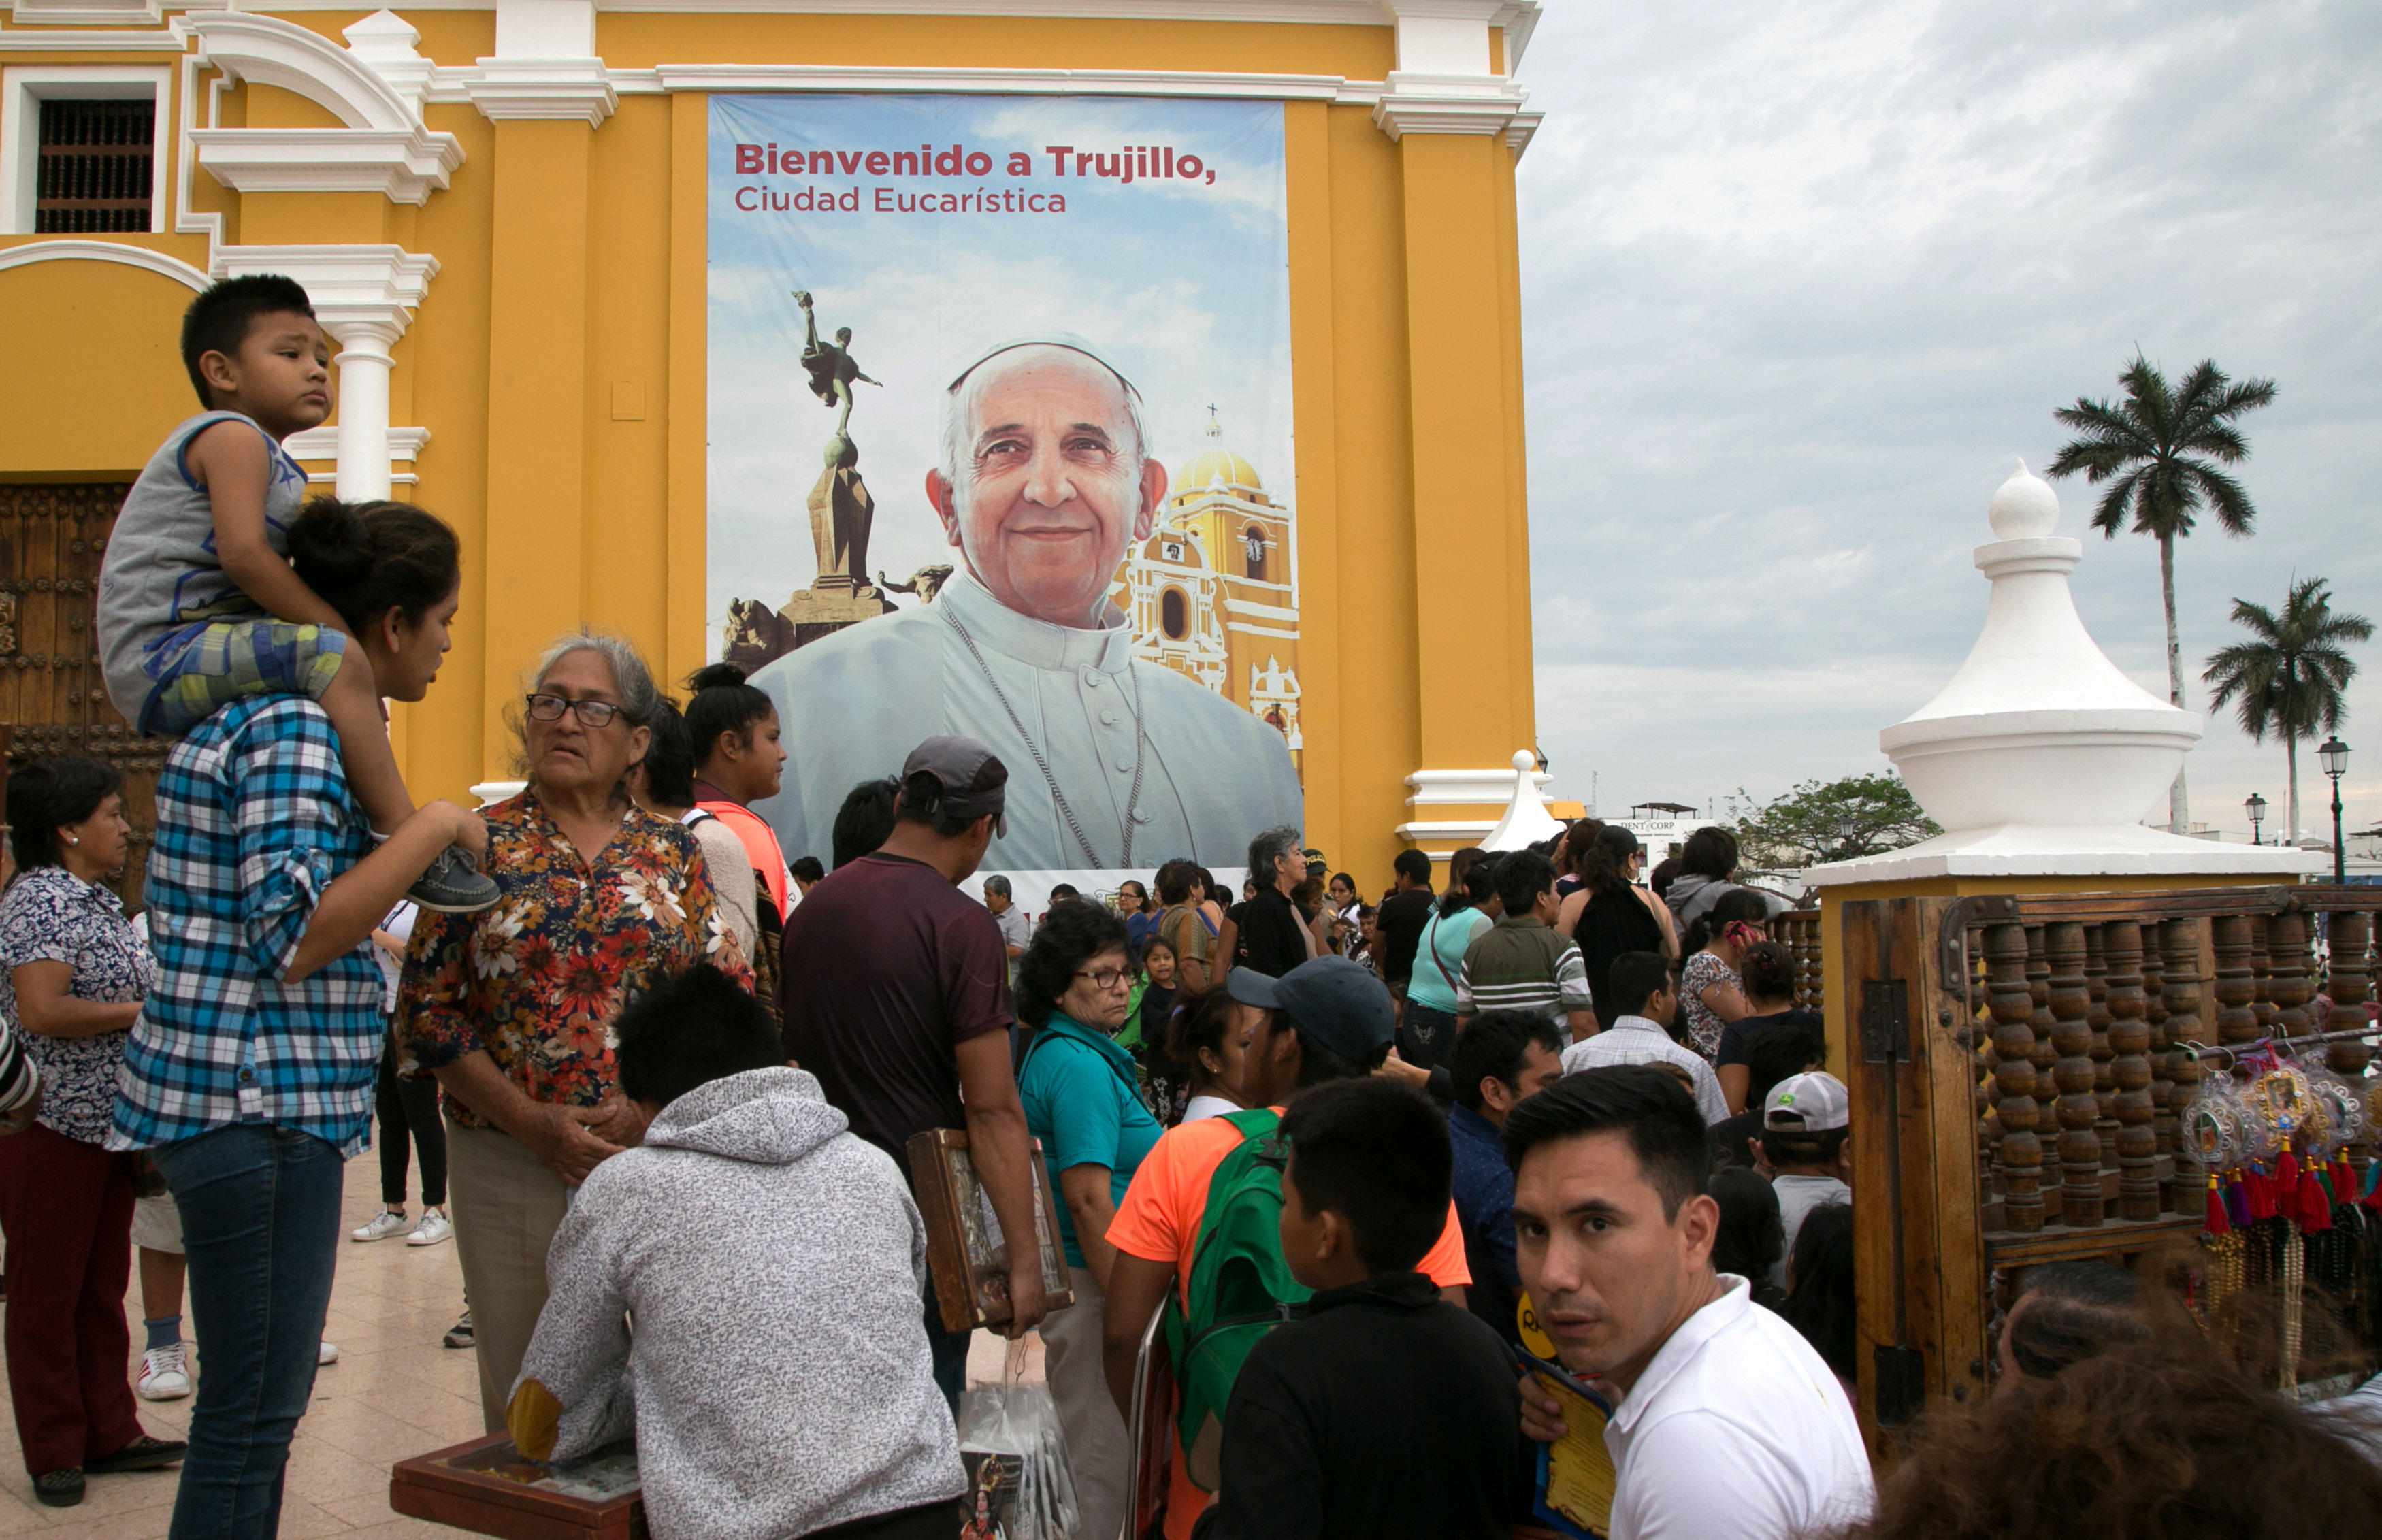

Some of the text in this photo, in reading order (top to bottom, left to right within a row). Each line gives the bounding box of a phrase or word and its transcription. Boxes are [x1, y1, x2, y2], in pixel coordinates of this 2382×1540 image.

[735, 143, 1216, 185] Bienvenido a Trujillo,
[735, 186, 1066, 212] Ciudad Eucarística
